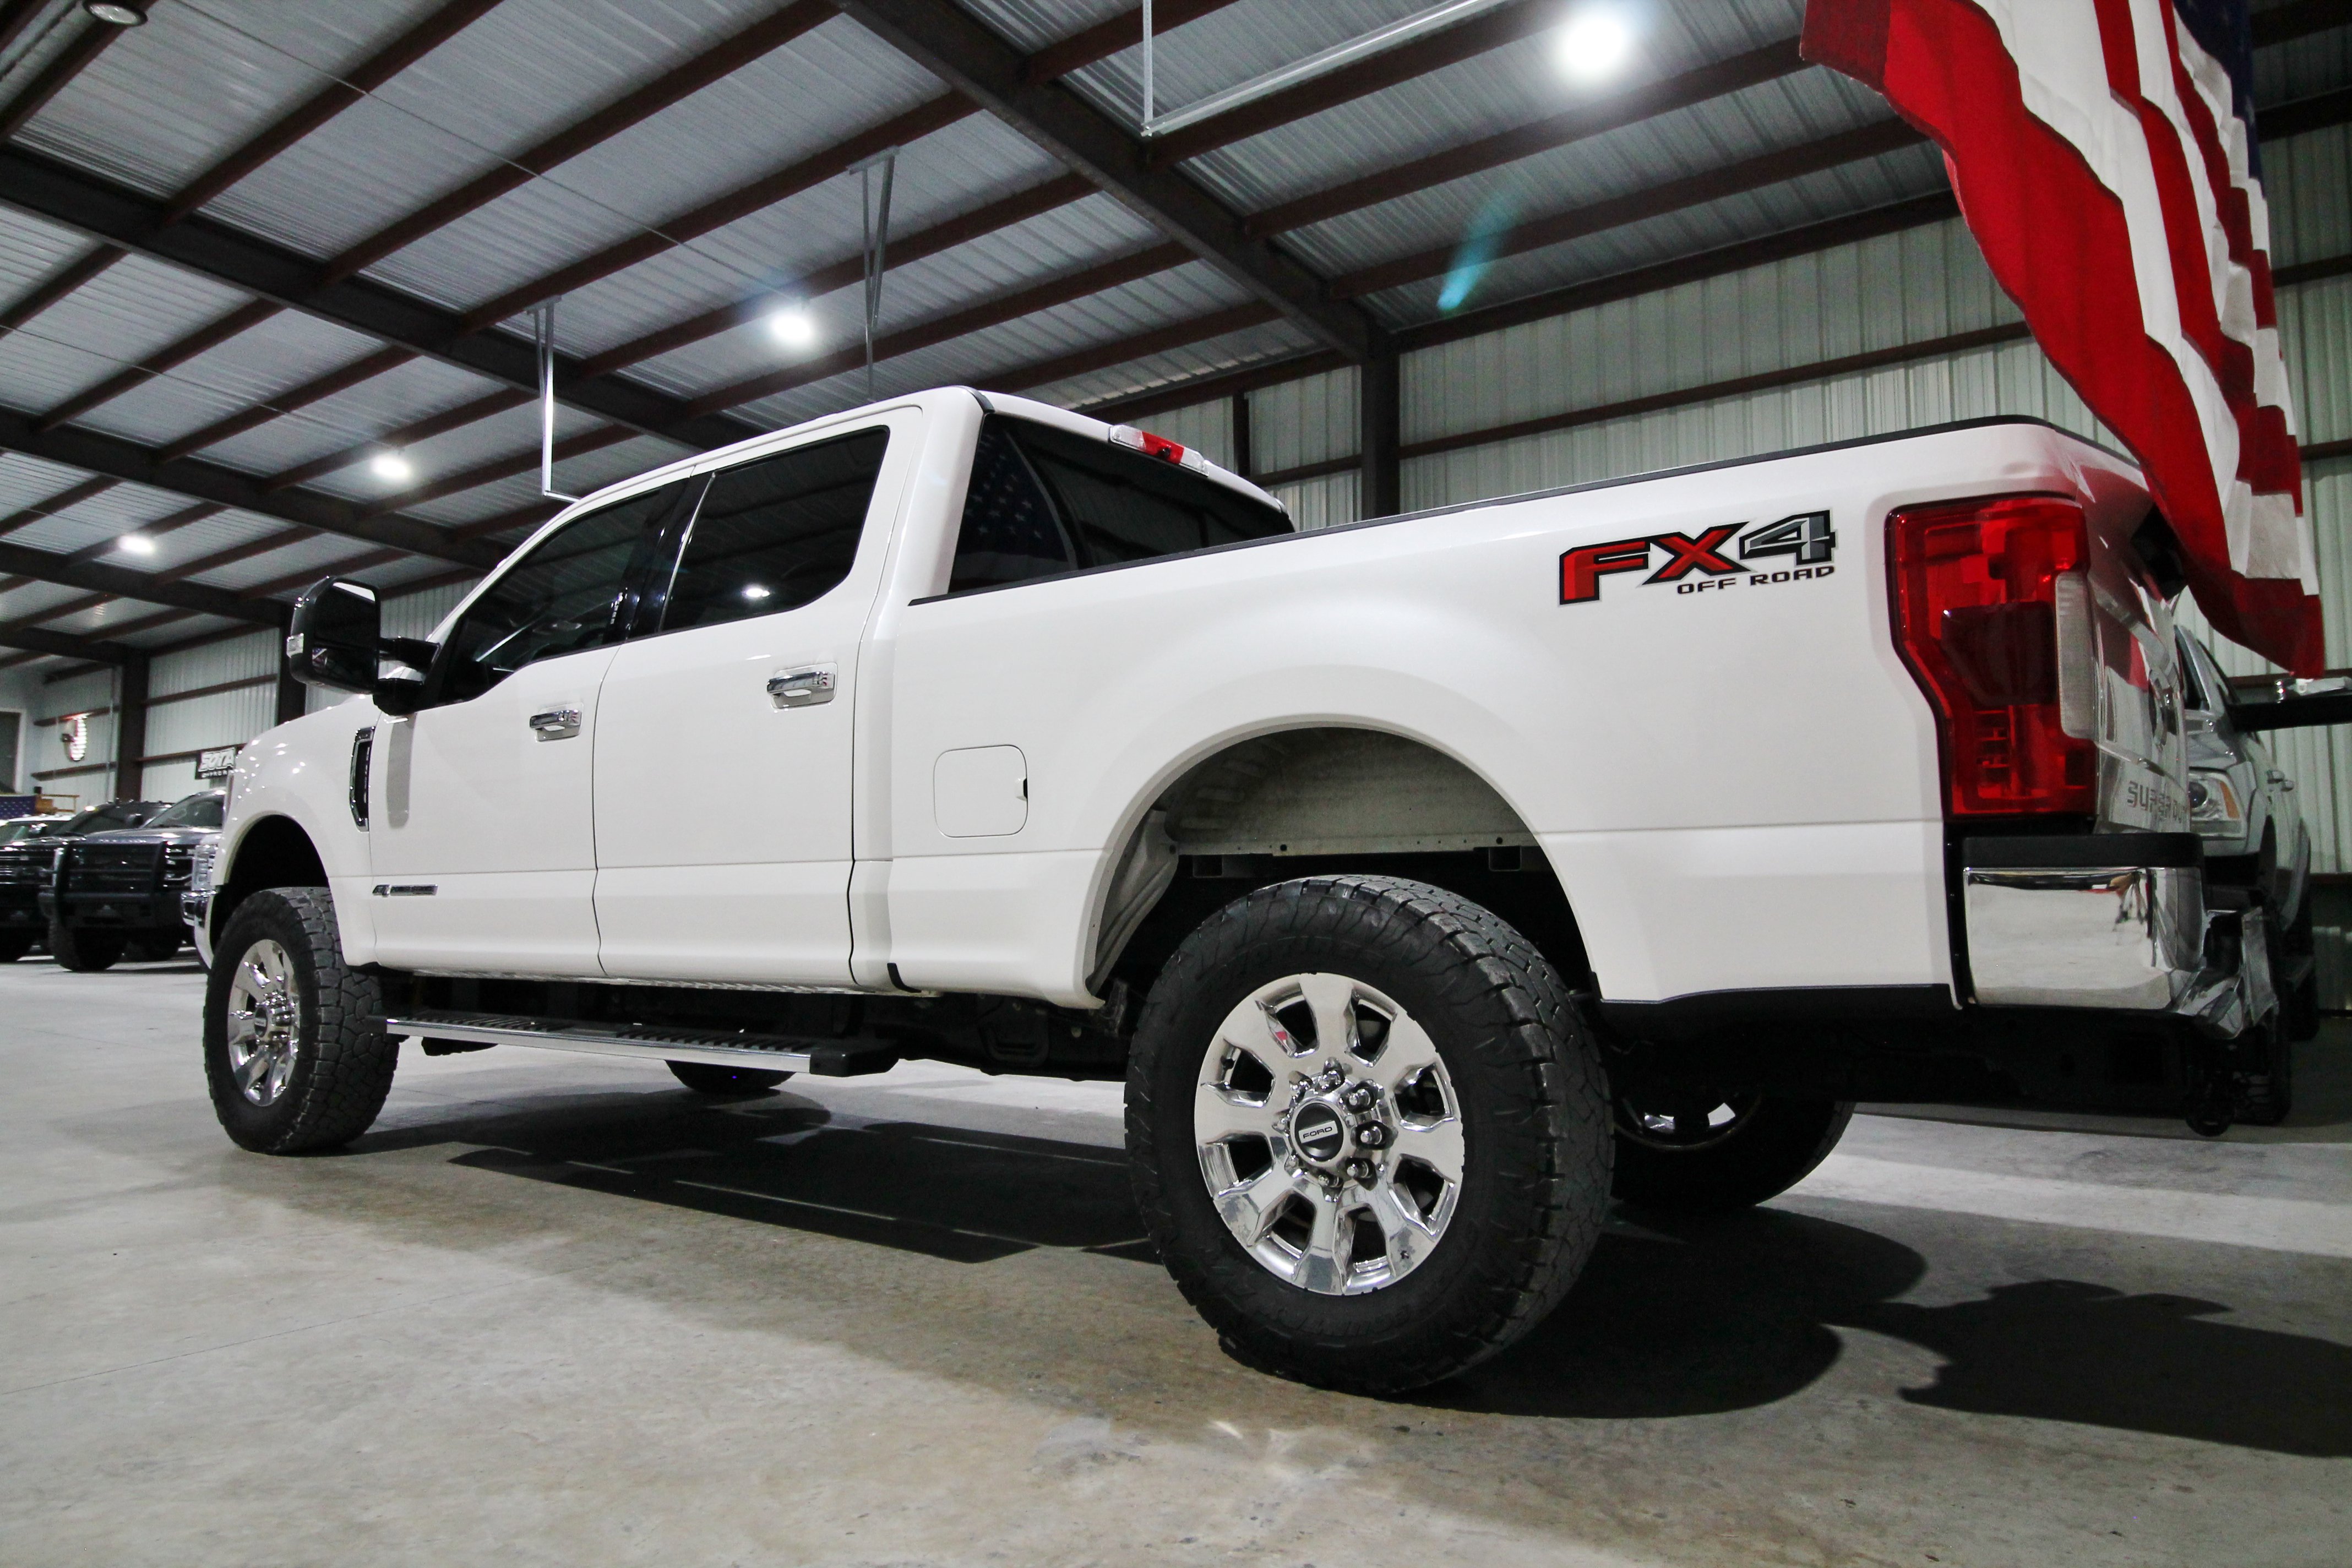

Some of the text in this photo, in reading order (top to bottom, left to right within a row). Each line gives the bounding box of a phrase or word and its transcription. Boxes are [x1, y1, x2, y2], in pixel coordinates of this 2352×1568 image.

[1559, 509, 1836, 605] FX4
[1677, 566, 1835, 595] OFF ROAD
[198, 747, 235, 772] SOTA
[2127, 781, 2171, 817] SUPER
[1303, 1126, 1333, 1139] FORD
